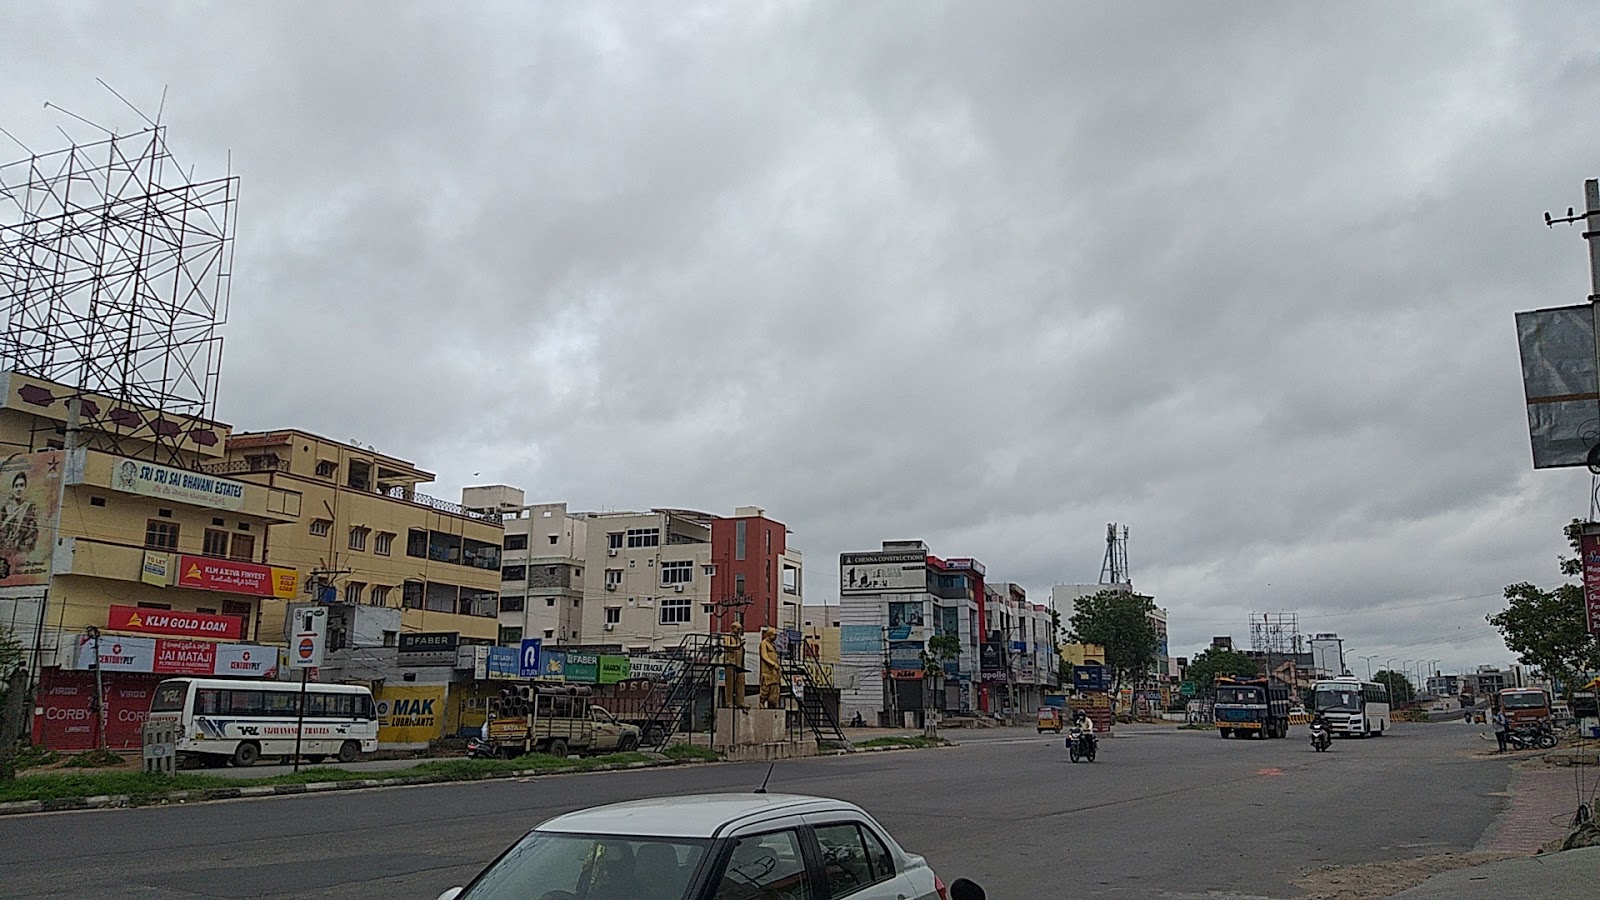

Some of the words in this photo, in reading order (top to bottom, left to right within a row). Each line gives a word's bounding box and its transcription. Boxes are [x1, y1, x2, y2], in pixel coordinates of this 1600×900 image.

[140, 466, 153, 481] SRI
[154, 470, 167, 484] SRI
[169, 472, 181, 487] SAI
[183, 474, 214, 493] BHAVANI
[215, 481, 243, 498] ESTATES
[205, 566, 218, 575] KLM
[145, 615, 169, 627] KLM
[170, 618, 199, 630] GOLD
[200, 621, 227, 632] LOAN
[414, 636, 448, 645] FABER
[159, 649, 176, 661] JAI
[177, 651, 212, 663] MATAJI
[573, 655, 598, 664] FABER
[629, 663, 643, 671] FAST
[982, 671, 1006, 680] apollo
[50, 687, 78, 696] VIRGO
[119, 690, 147, 699] VIRGO
[392, 698, 436, 715] MAK
[46, 707, 92, 721] CORBY
[391, 717, 434, 727] LUBRICANTS
